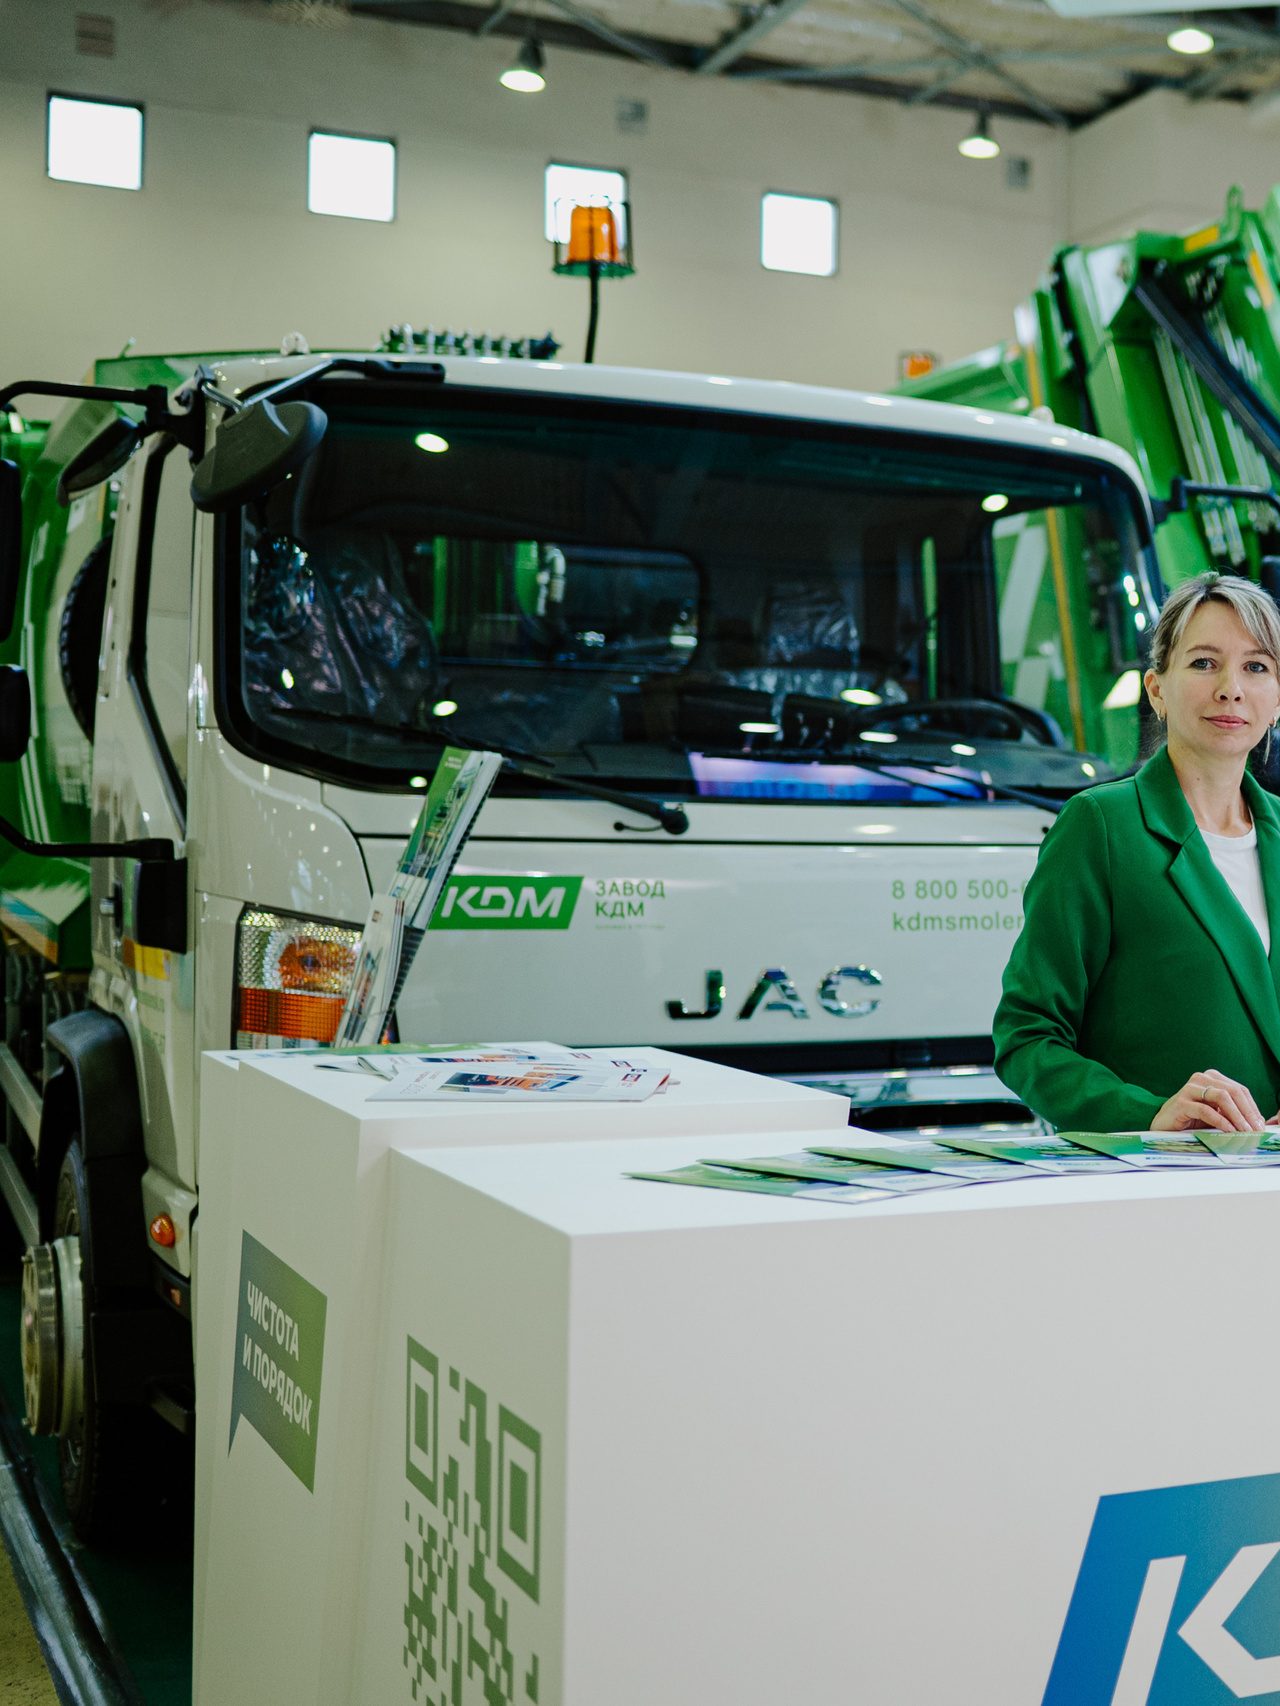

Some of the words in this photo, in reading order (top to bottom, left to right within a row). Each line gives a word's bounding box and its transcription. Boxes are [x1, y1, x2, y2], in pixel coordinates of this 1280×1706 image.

[595, 880, 665, 899] ЗАВОД
[892, 880, 905, 899] 8
[915, 880, 958, 899] 800
[595, 901, 645, 919] КДМ
[893, 911, 1026, 931] kdmsmolen
[665, 964, 884, 1020] JAC
[247, 1280, 300, 1362] ЧИСТОТА
[242, 1332, 251, 1372] И
[252, 1344, 313, 1437] ПОРЯДОК
